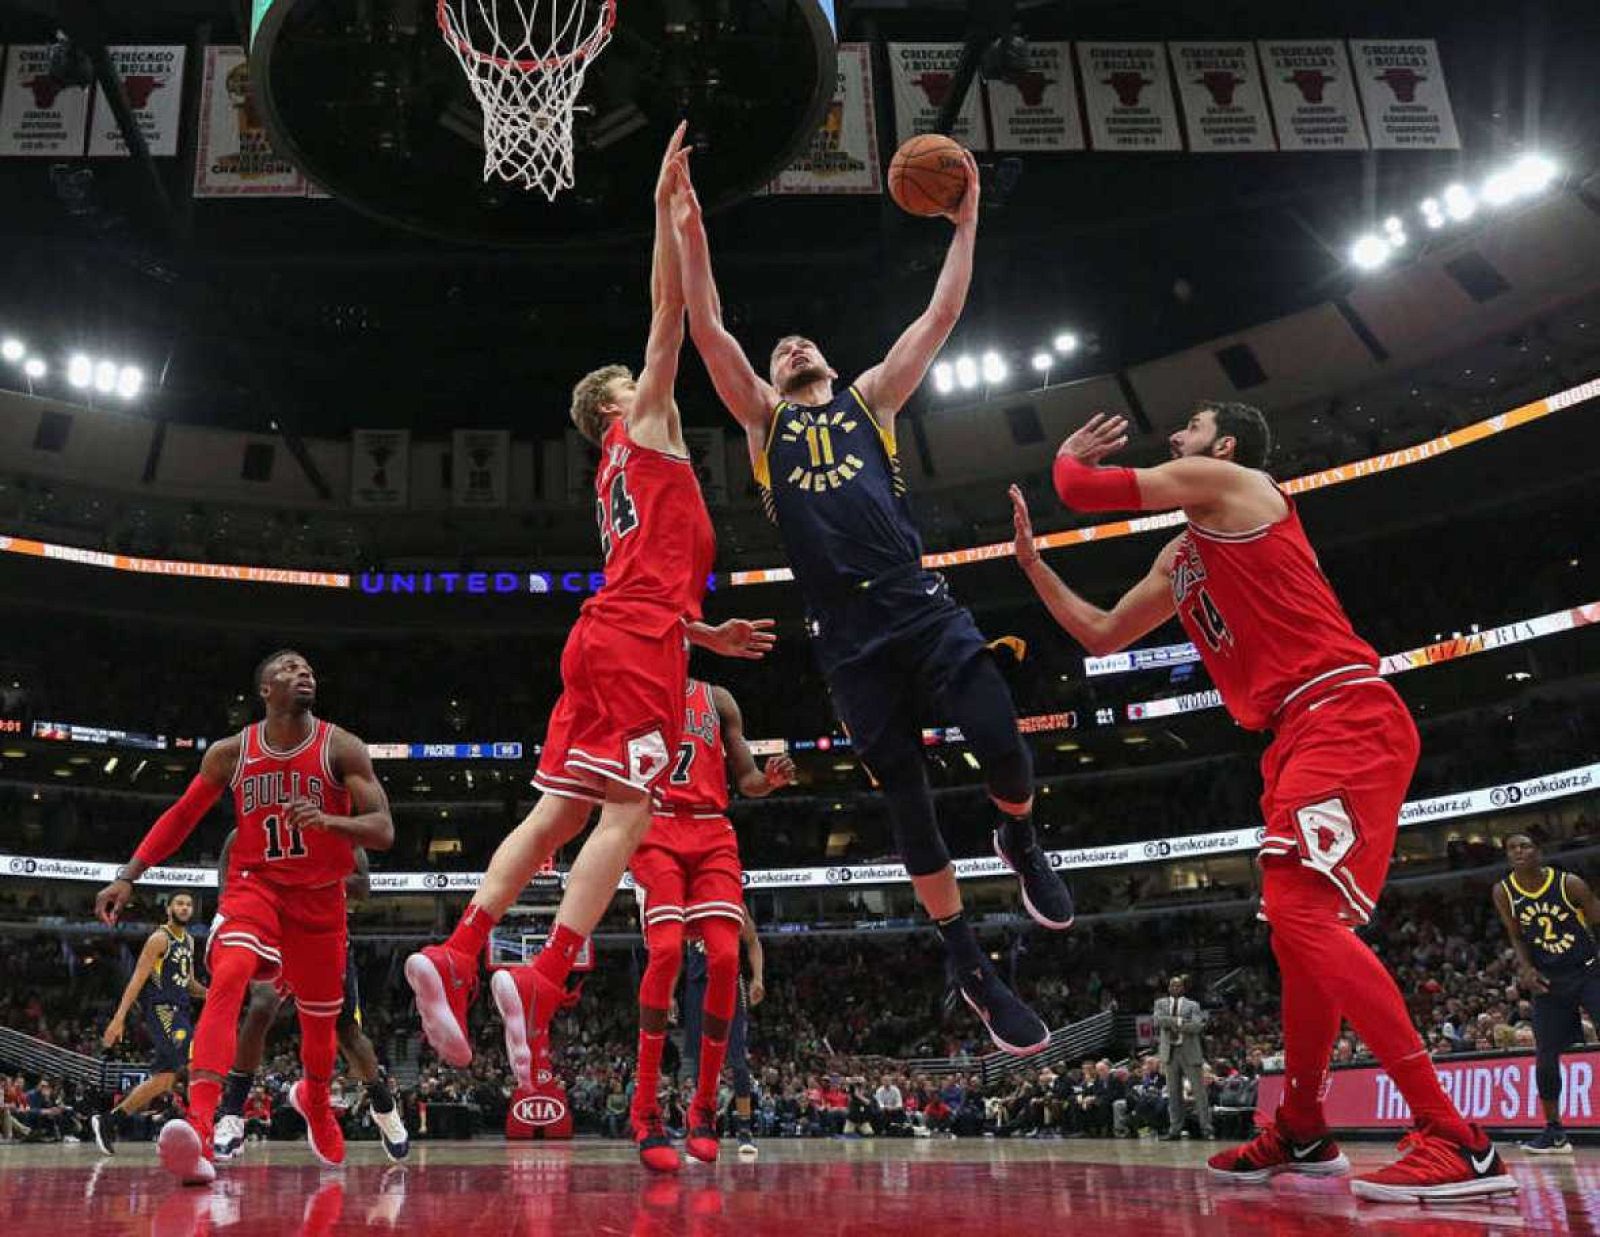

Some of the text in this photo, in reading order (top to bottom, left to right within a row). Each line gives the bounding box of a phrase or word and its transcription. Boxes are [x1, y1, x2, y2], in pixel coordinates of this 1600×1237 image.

[807, 426, 834, 467] 11
[1355, 436, 1453, 477] PIZZERIA
[788, 453, 865, 492] PACERS
[128, 558, 240, 579] NEAPOLITAN
[248, 567, 329, 585] PIZZERIA
[360, 571, 519, 593] UNITED
[669, 740, 697, 785] 7
[243, 769, 325, 816] BULLS
[1523, 772, 1593, 797] cinkciarz.pl
[262, 813, 308, 862] 11
[1172, 835, 1239, 853] cinkciarz.pl
[1537, 915, 1558, 940] 2
[521, 1101, 557, 1119] KIA
